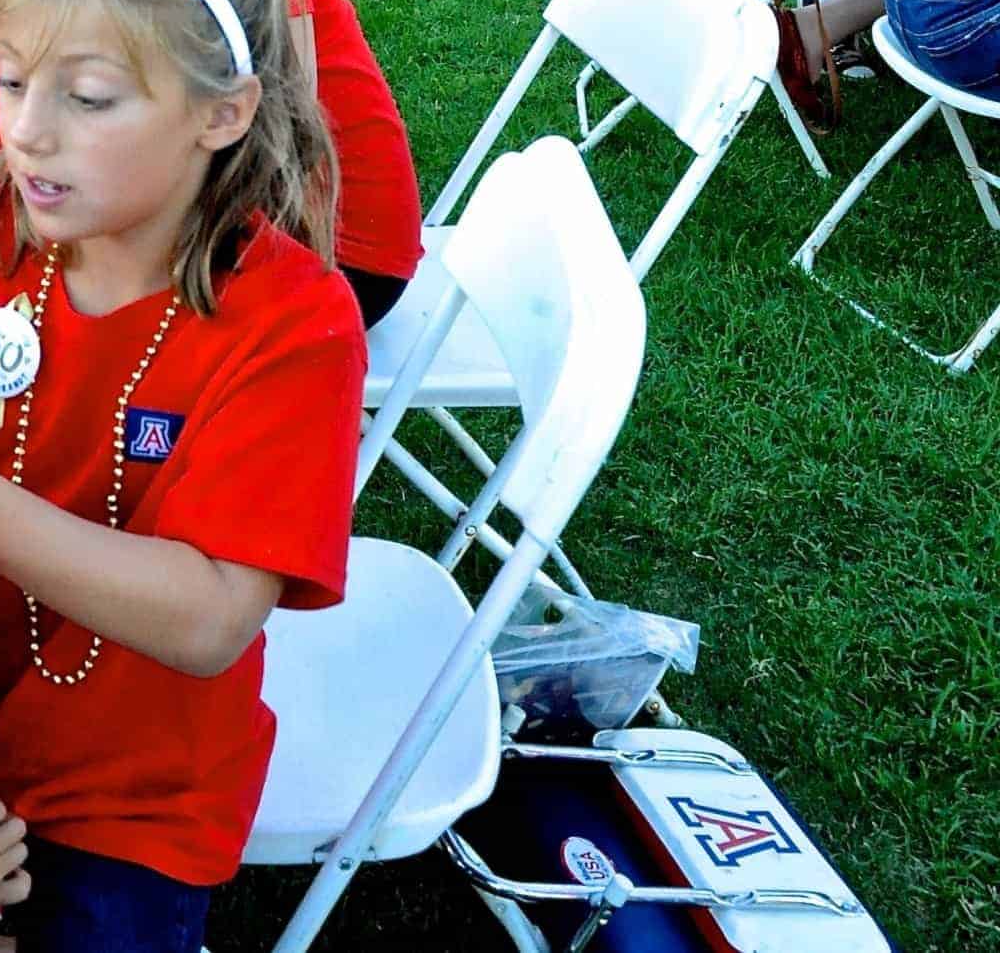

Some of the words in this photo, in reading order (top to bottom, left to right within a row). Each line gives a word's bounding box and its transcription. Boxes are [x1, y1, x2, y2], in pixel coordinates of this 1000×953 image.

[130, 416, 172, 458] A
[666, 796, 801, 867] A
[579, 851, 605, 880] USA
